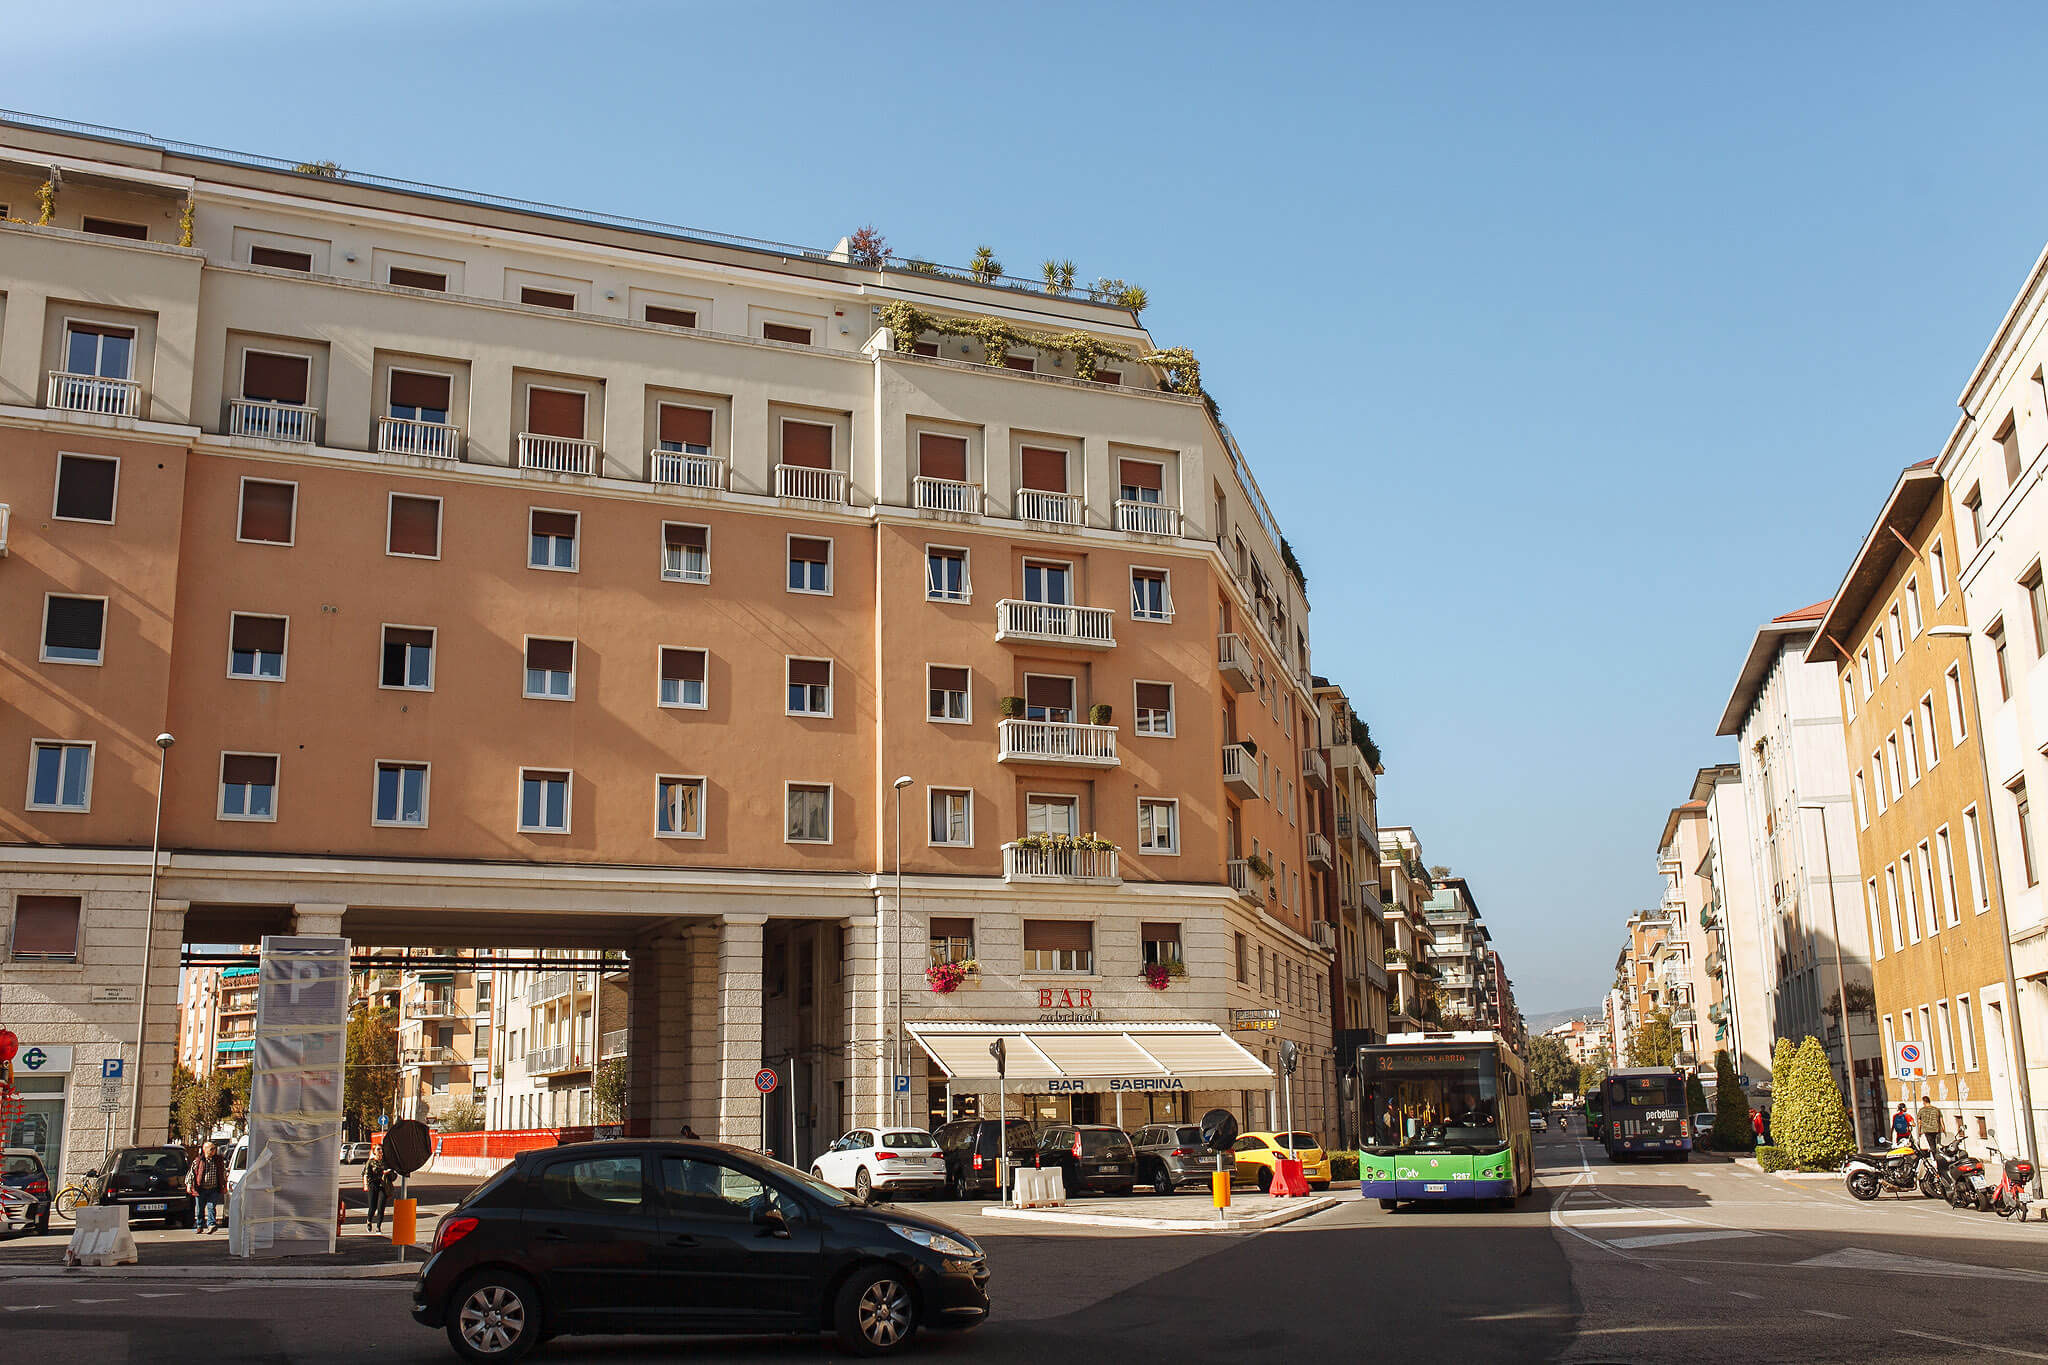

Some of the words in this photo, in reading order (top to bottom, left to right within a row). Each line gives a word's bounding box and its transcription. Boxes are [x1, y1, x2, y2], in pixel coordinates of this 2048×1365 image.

[1039, 988, 1093, 1008] BAR
[1236, 1009, 1281, 1019] PELLINI
[105, 1060, 120, 1077] P
[1379, 1056, 1393, 1071] 32
[897, 1077, 907, 1091] P
[1049, 1080, 1084, 1090] BAR
[1110, 1078, 1183, 1090] SABRINA
[1641, 1079, 1650, 1088] 23
